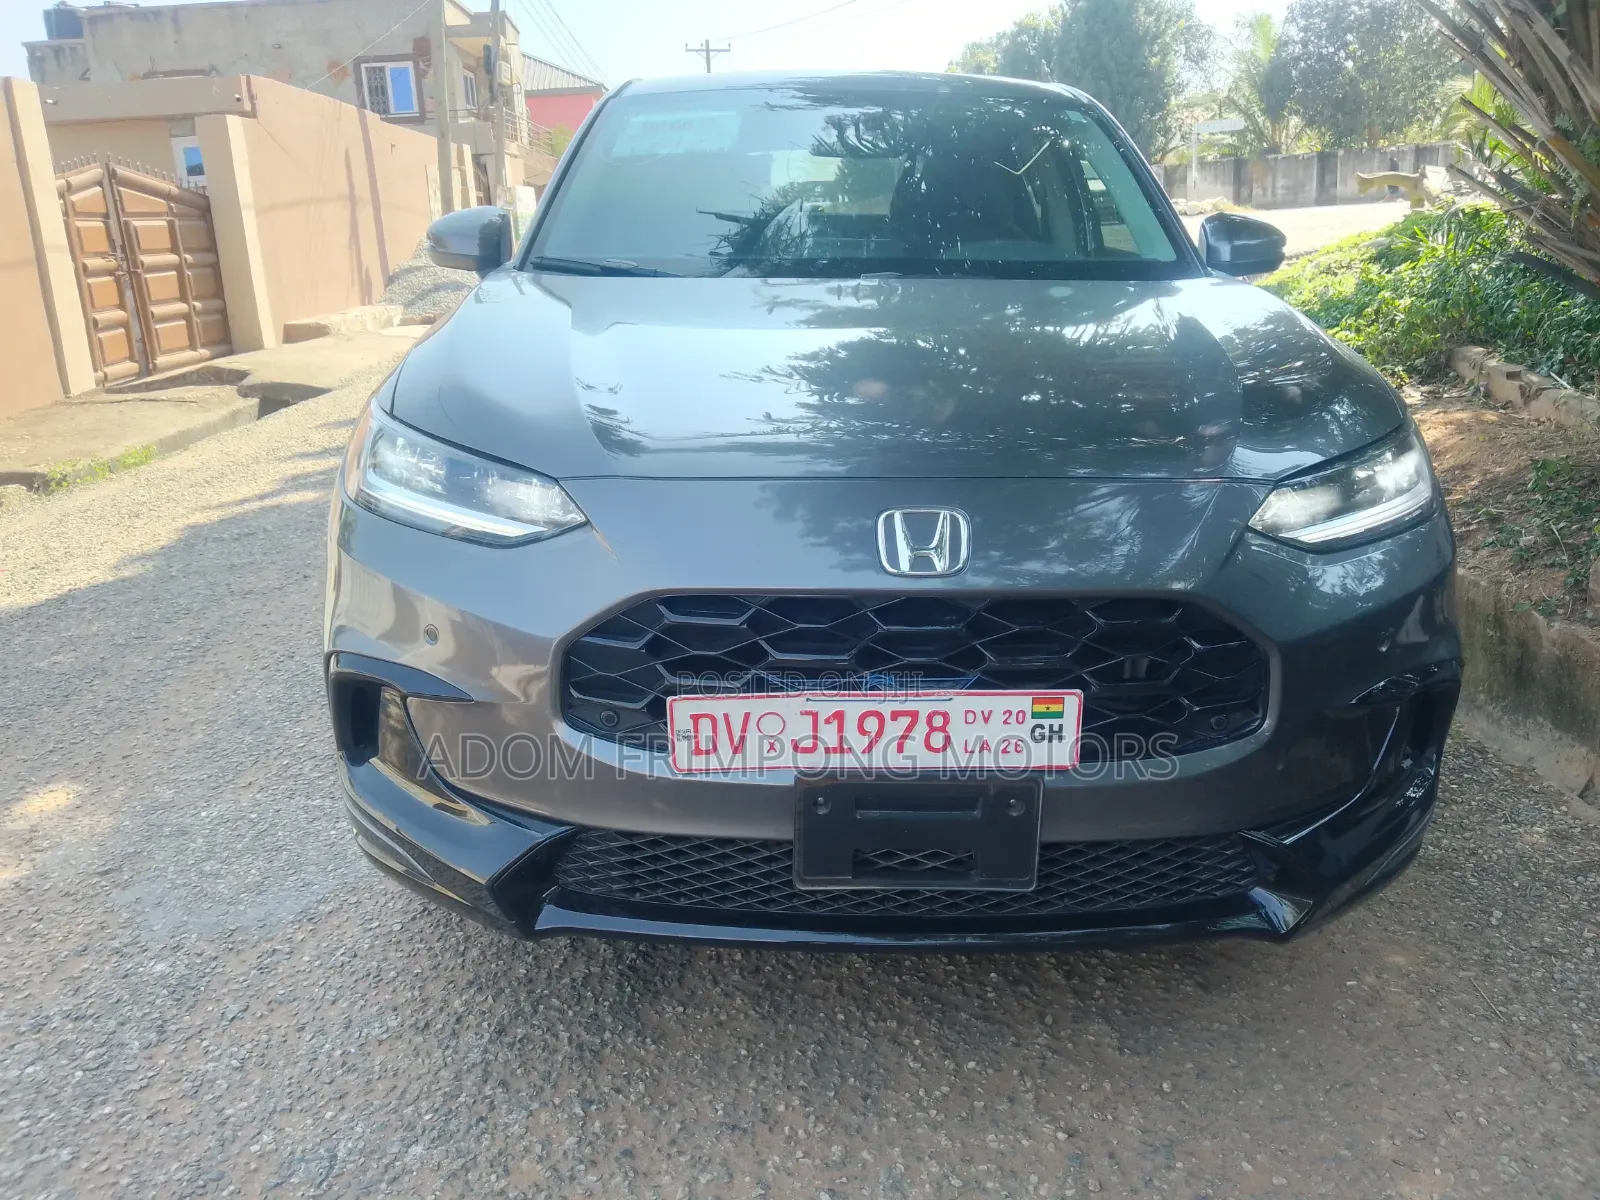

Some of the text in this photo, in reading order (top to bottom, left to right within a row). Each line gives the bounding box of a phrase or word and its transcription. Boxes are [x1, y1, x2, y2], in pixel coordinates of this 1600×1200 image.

[963, 709, 1027, 725] DV 20
[688, 709, 952, 756] DV J1978
[1029, 723, 1064, 744] GH
[963, 738, 1025, 754] LA 26
